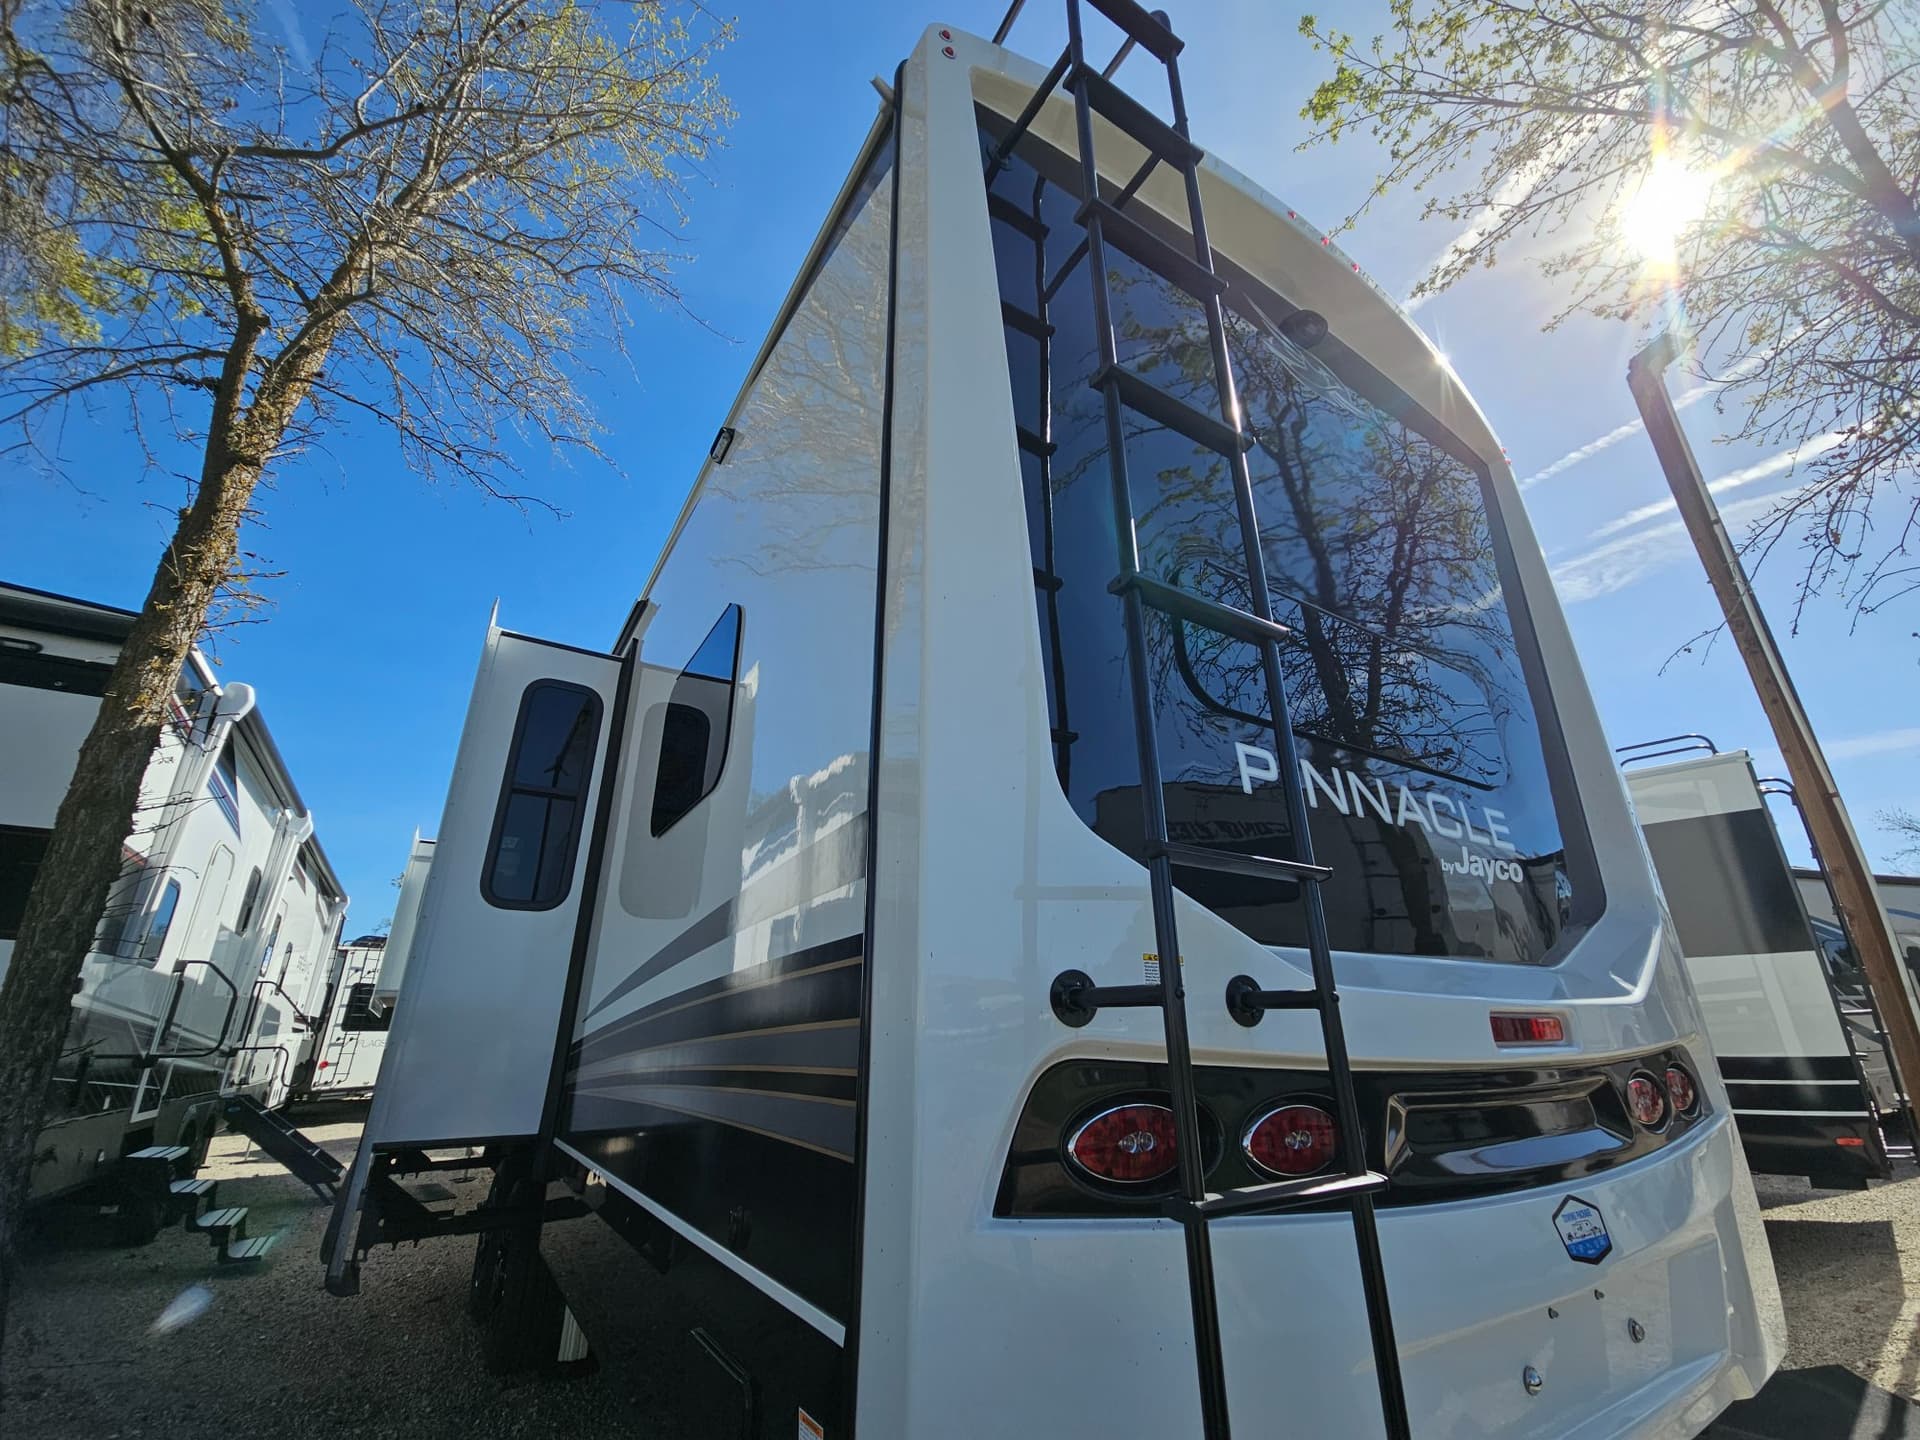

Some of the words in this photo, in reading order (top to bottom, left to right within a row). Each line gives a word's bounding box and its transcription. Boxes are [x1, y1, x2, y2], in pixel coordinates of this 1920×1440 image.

[1234, 741, 1516, 852] PNNACLE
[1440, 858, 1455, 875] by
[1455, 846, 1524, 884] Jayco
